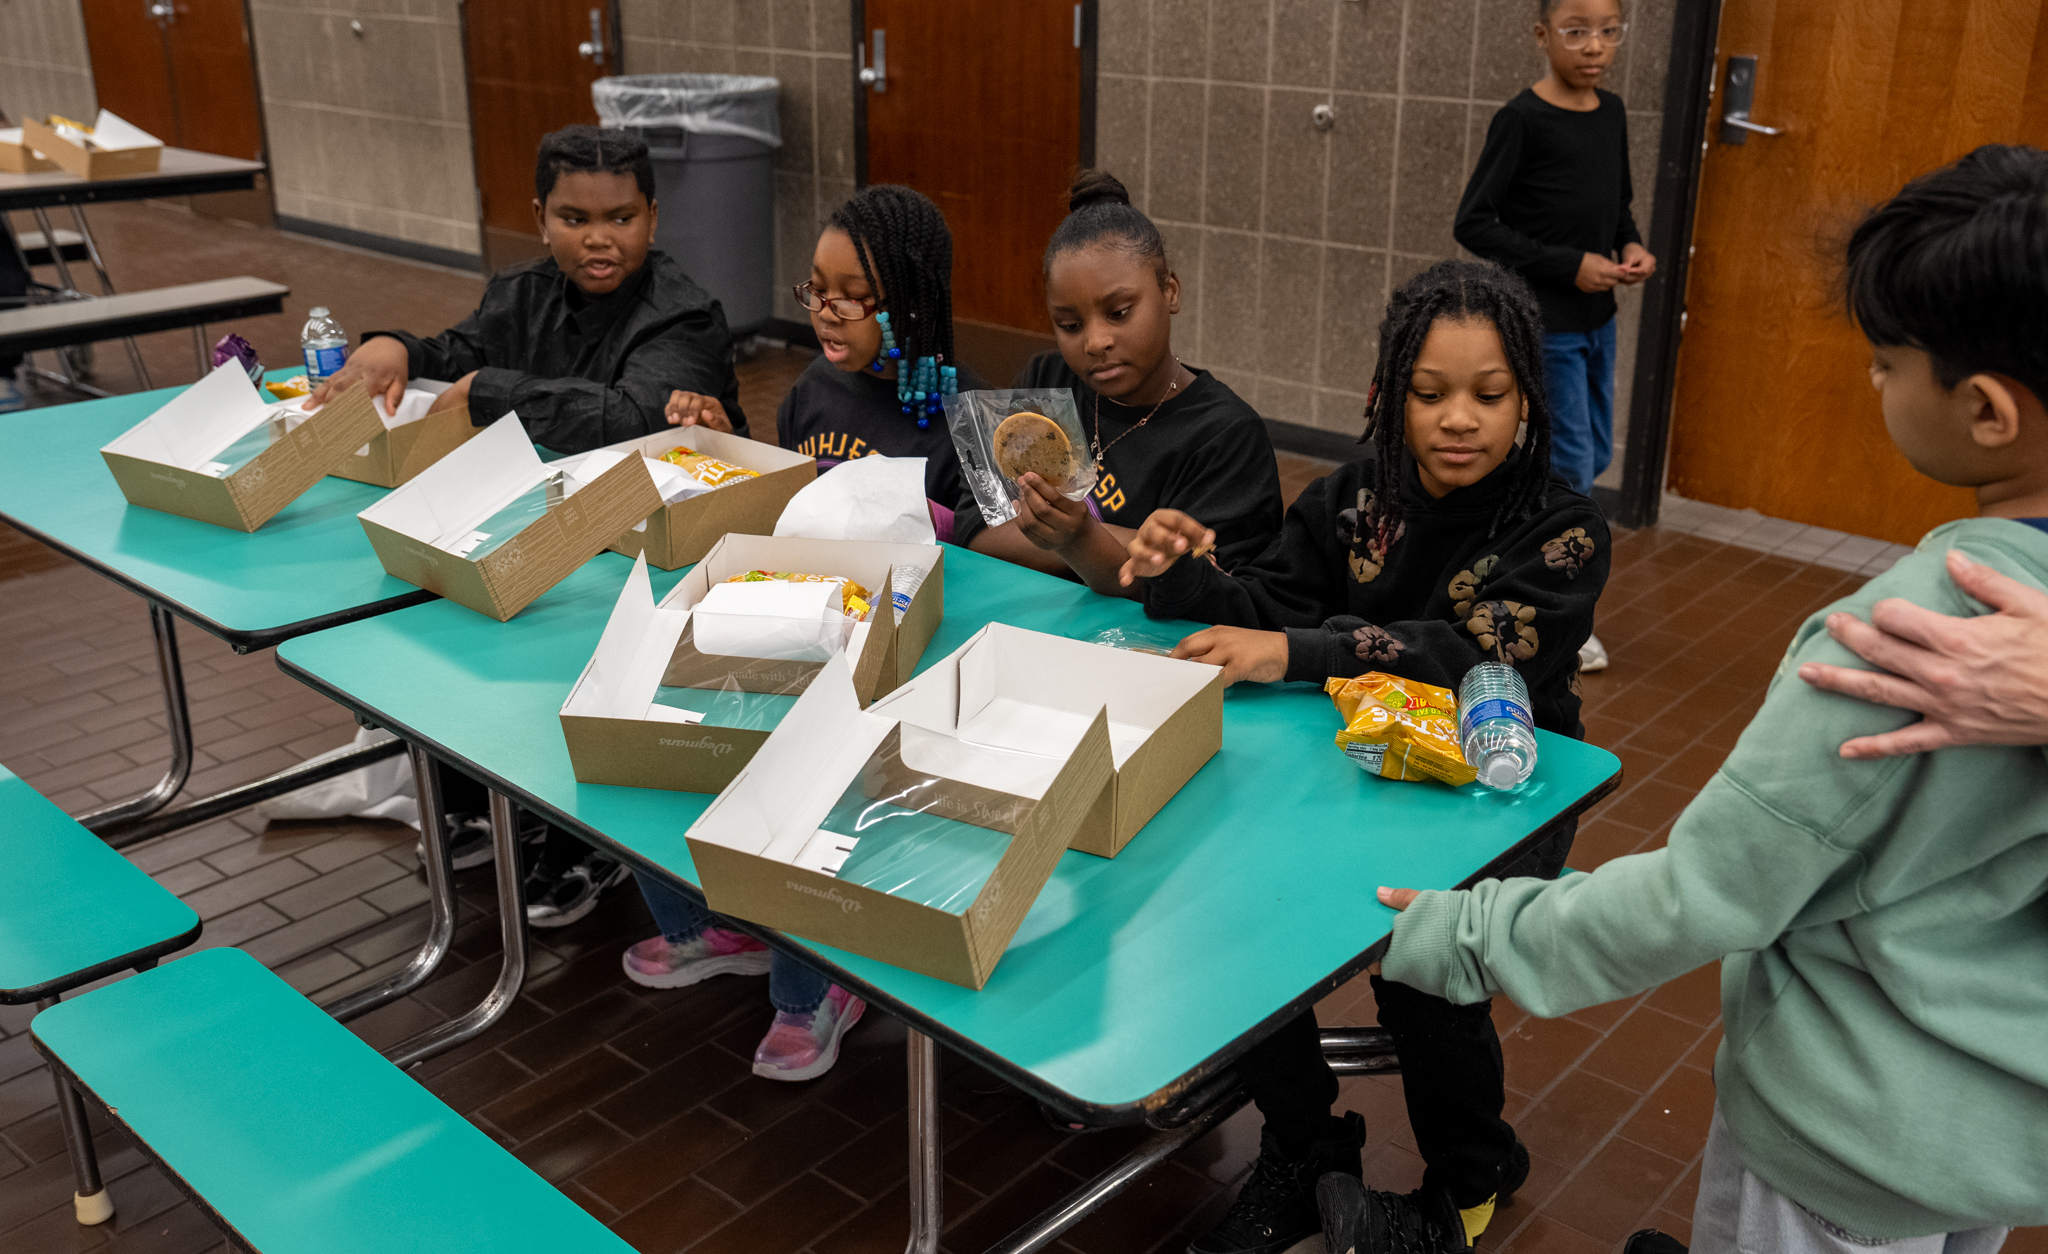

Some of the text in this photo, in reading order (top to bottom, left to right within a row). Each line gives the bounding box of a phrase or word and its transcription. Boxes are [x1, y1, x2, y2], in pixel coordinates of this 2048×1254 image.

[728, 669, 759, 680] made
[761, 671, 786, 682] with
[659, 735, 736, 758] Wegmans
[934, 792, 955, 810] life
[956, 799, 968, 813] is
[786, 880, 864, 914] Wegmans
